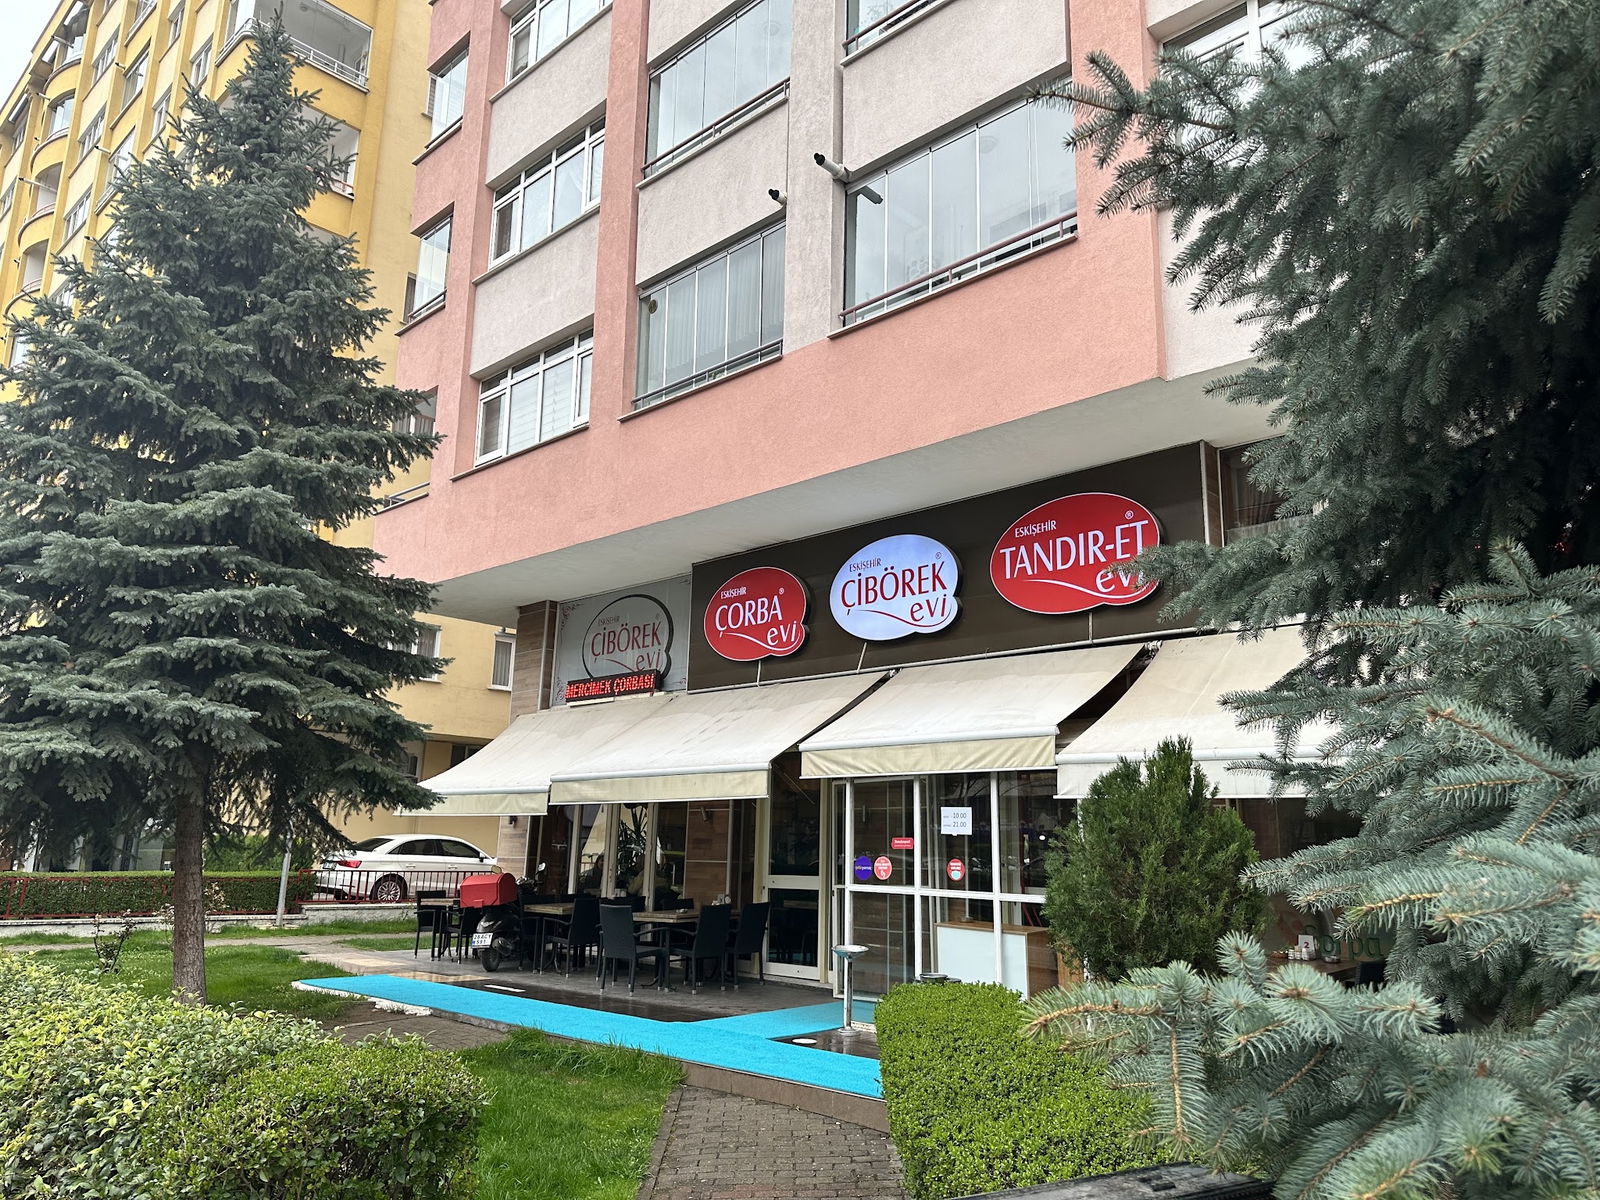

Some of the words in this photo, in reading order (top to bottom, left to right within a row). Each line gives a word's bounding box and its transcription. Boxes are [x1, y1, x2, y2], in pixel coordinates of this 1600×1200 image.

[1014, 519, 1057, 539] ESKİŞEHİR
[999, 519, 1149, 580] TANDIR-ET
[849, 556, 882, 573] ESKİŞEHİR
[720, 586, 747, 599] ESKİŞEHİR
[840, 560, 947, 616] ÇİBÖREK
[715, 595, 783, 638] ÇORBA
[909, 594, 948, 622] evi
[591, 620, 662, 663] ÇİBÖREK
[766, 620, 797, 647] evi
[635, 648, 661, 672] evi
